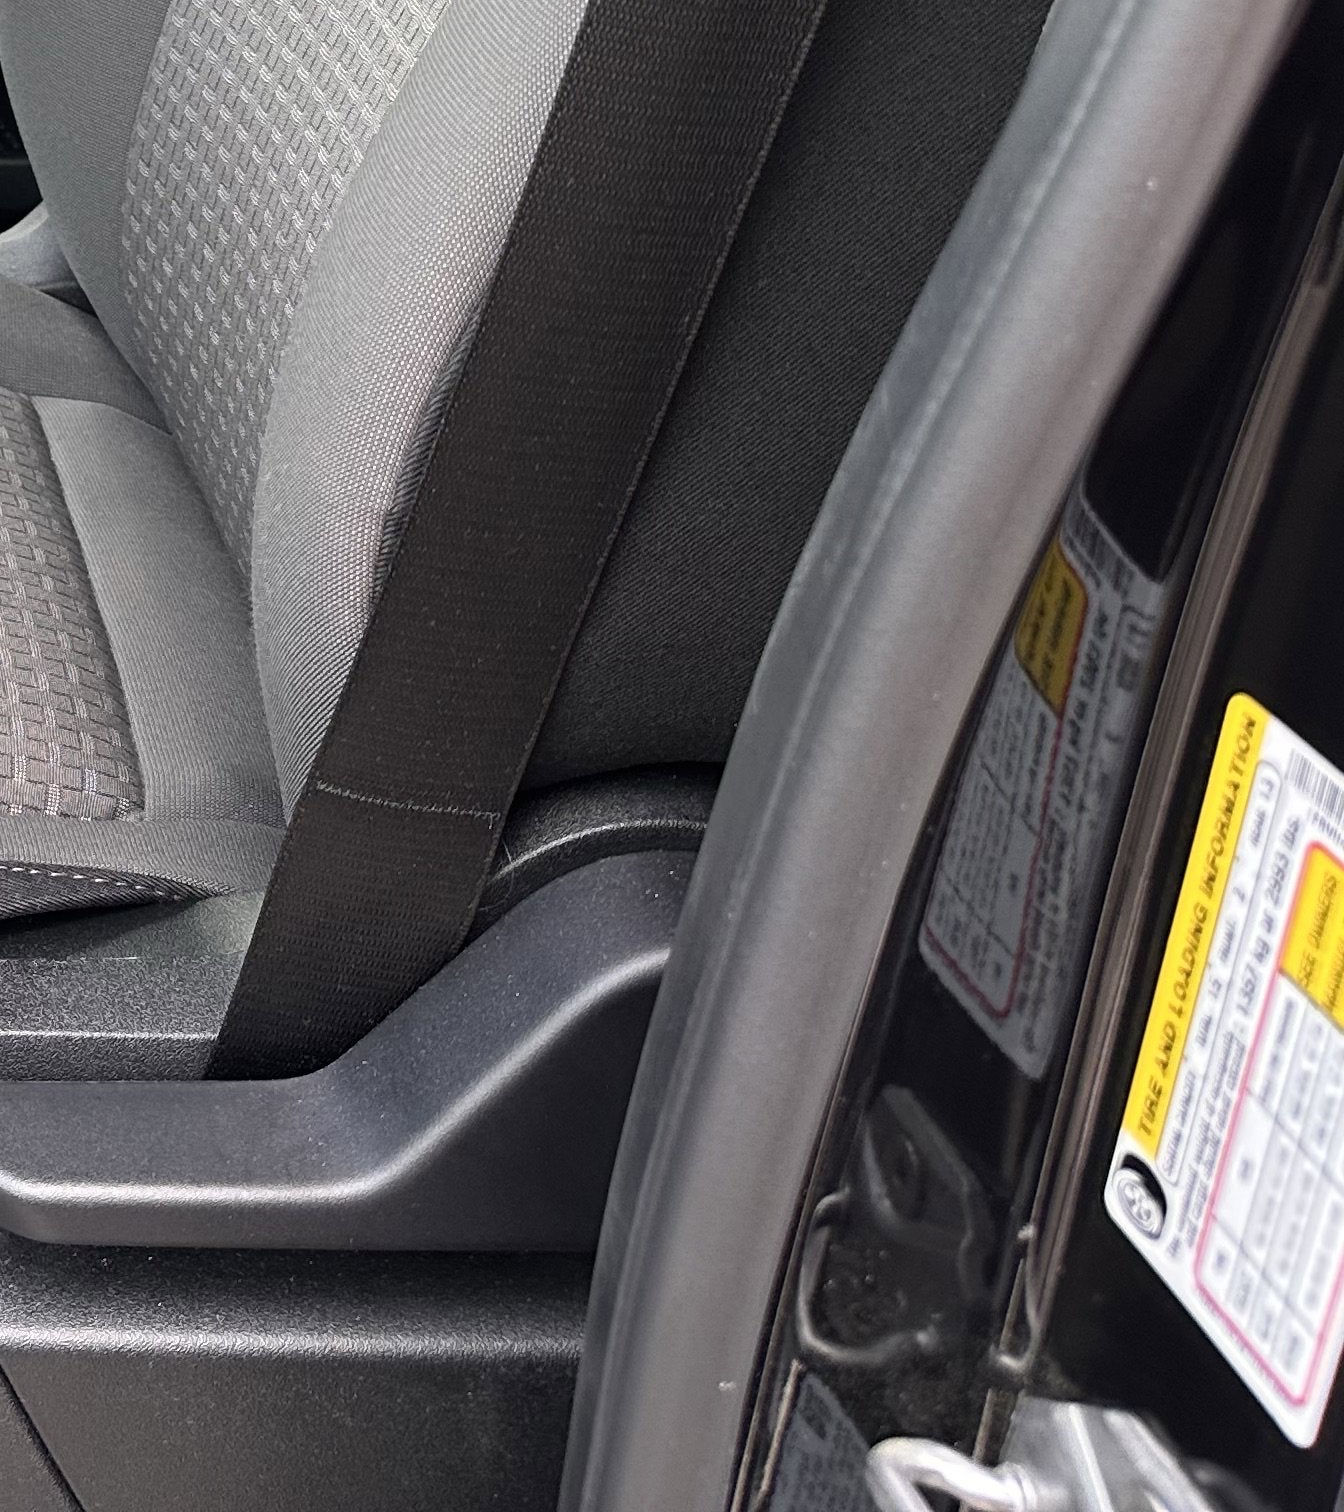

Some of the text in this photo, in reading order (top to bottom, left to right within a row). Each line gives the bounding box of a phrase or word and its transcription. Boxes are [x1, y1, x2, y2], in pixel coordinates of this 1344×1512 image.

[1137, 712, 1257, 1137] TIRE AND LOADING INFORMATION
[1253, 938, 1271, 964] kg
